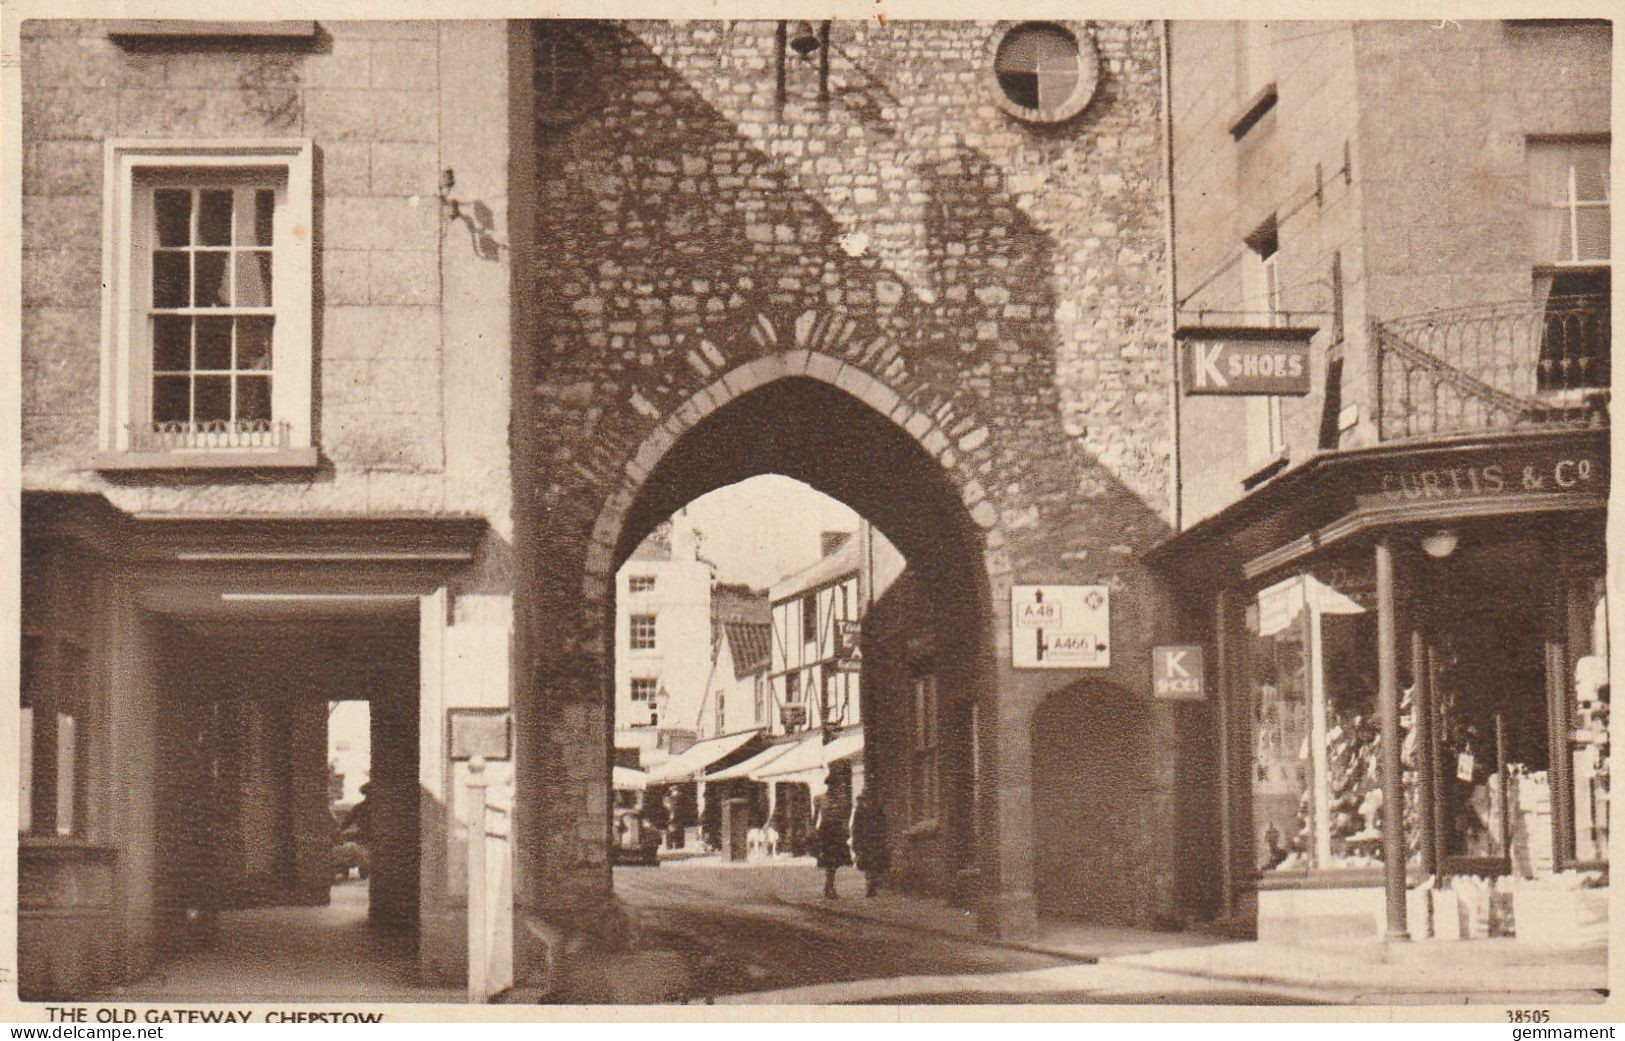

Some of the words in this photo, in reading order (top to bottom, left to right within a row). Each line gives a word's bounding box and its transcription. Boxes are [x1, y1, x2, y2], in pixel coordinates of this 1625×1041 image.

[1195, 342, 1228, 387] K
[1228, 352, 1303, 378] SHOES
[1522, 465, 1543, 490] &
[1055, 638, 1088, 649] A466
[1166, 652, 1190, 677] K
[1157, 678, 1199, 692] SHOES
[45, 1007, 88, 1023] THE
[96, 1008, 137, 1023] OLD
[144, 1009, 253, 1023] GATEWAY
[265, 1011, 384, 1023] CHEPSTOW
[1506, 1009, 1551, 1023] 38505
